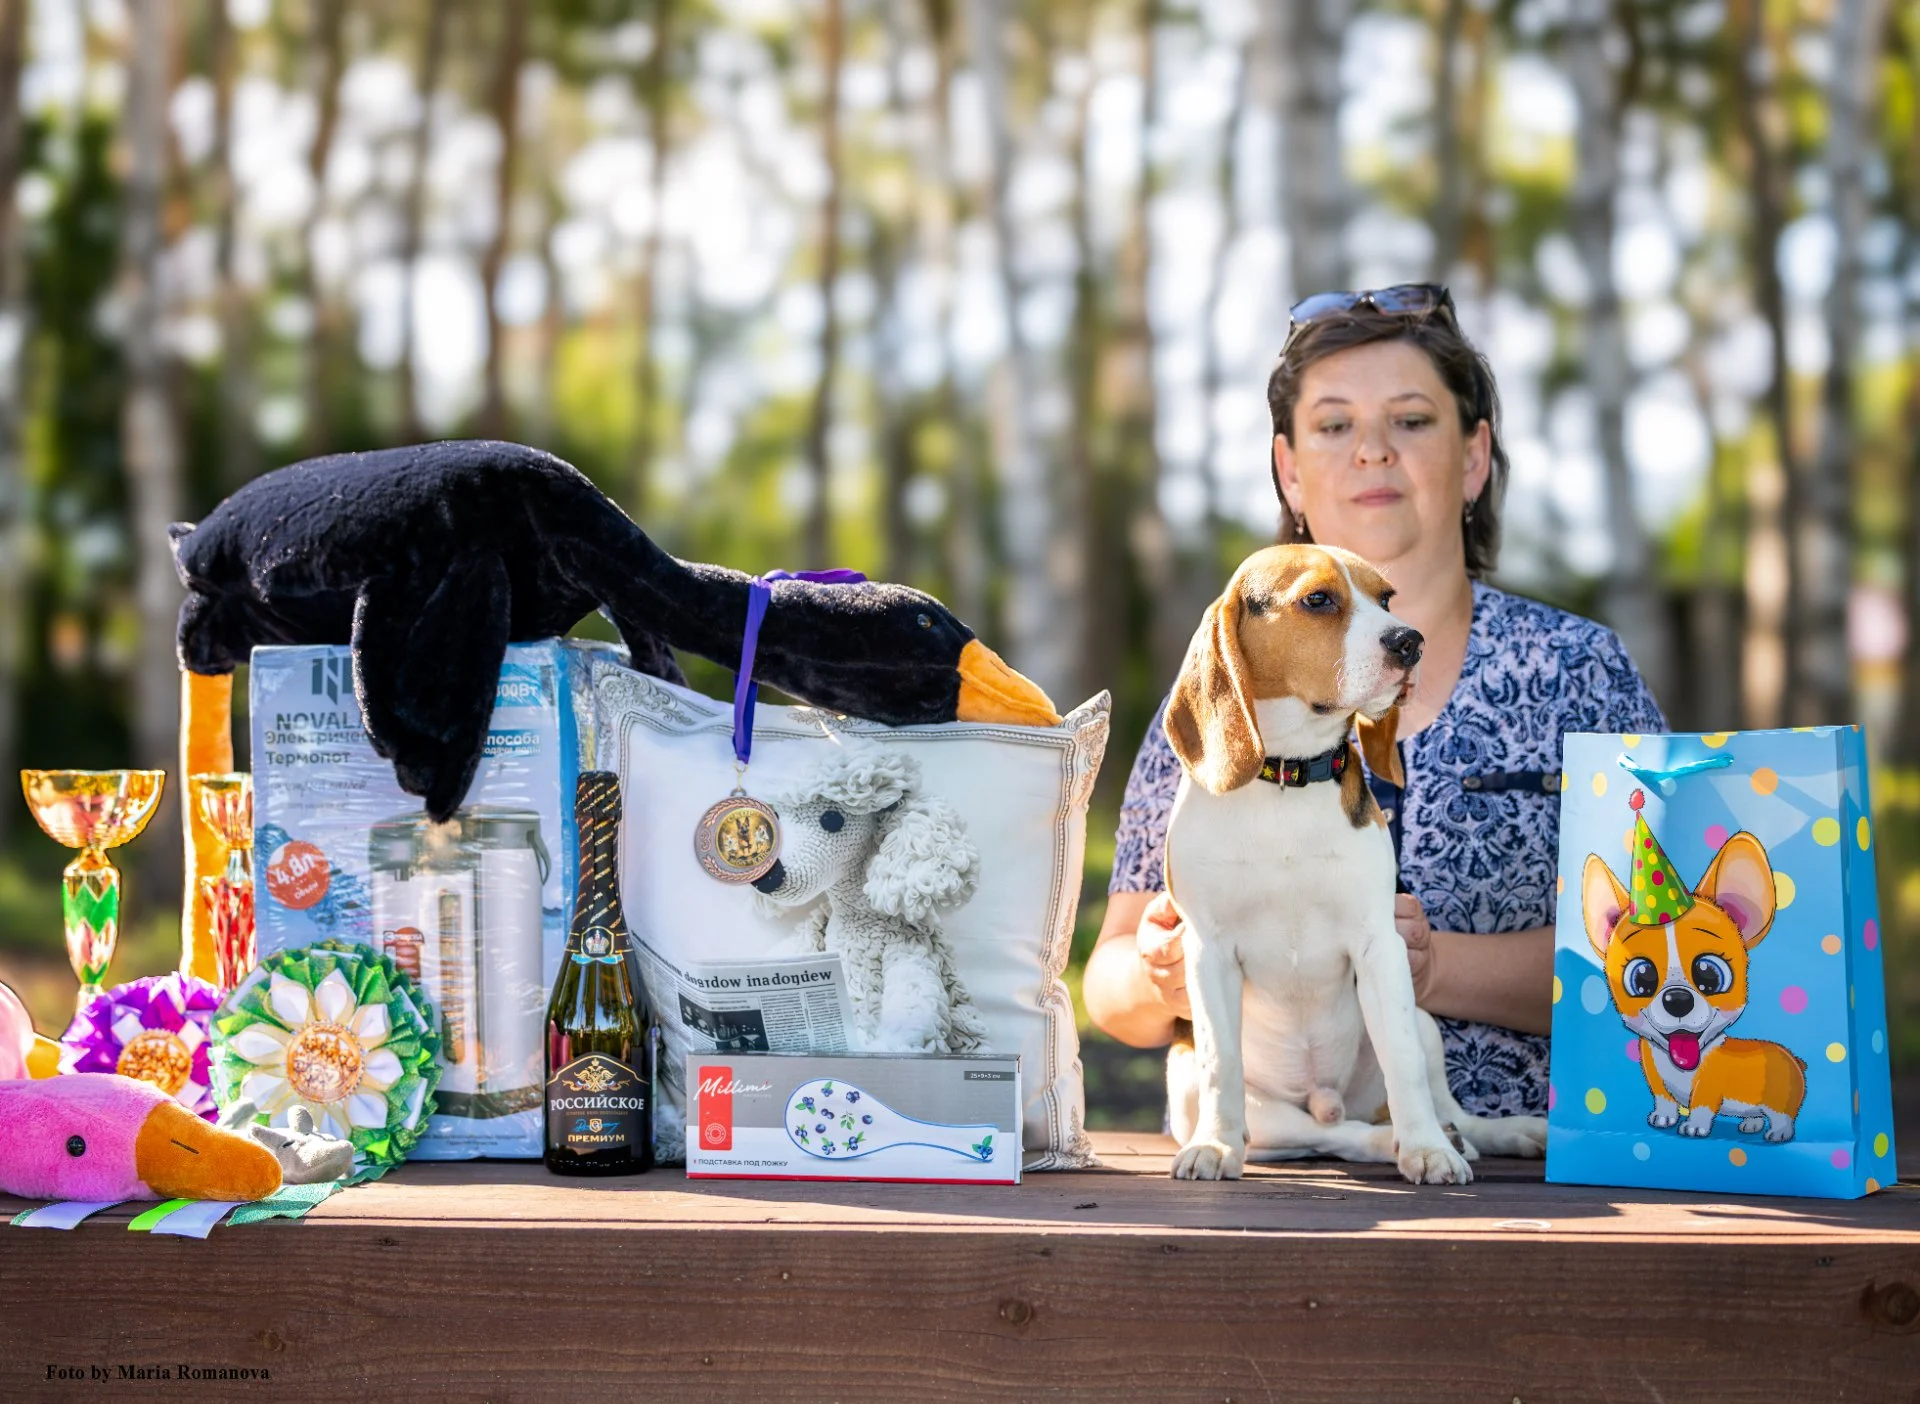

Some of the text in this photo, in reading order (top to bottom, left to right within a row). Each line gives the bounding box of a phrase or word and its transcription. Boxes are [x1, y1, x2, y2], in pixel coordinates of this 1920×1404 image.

[276, 711, 365, 731] NOVAL
[264, 751, 351, 767] Термопот
[550, 1094, 645, 1111] РОССИЙСКОЕ
[567, 1134, 625, 1143] ПРЕМИУМ
[698, 1158, 742, 1166] ПОДСТАВКА
[743, 1159, 760, 1167] ПОД
